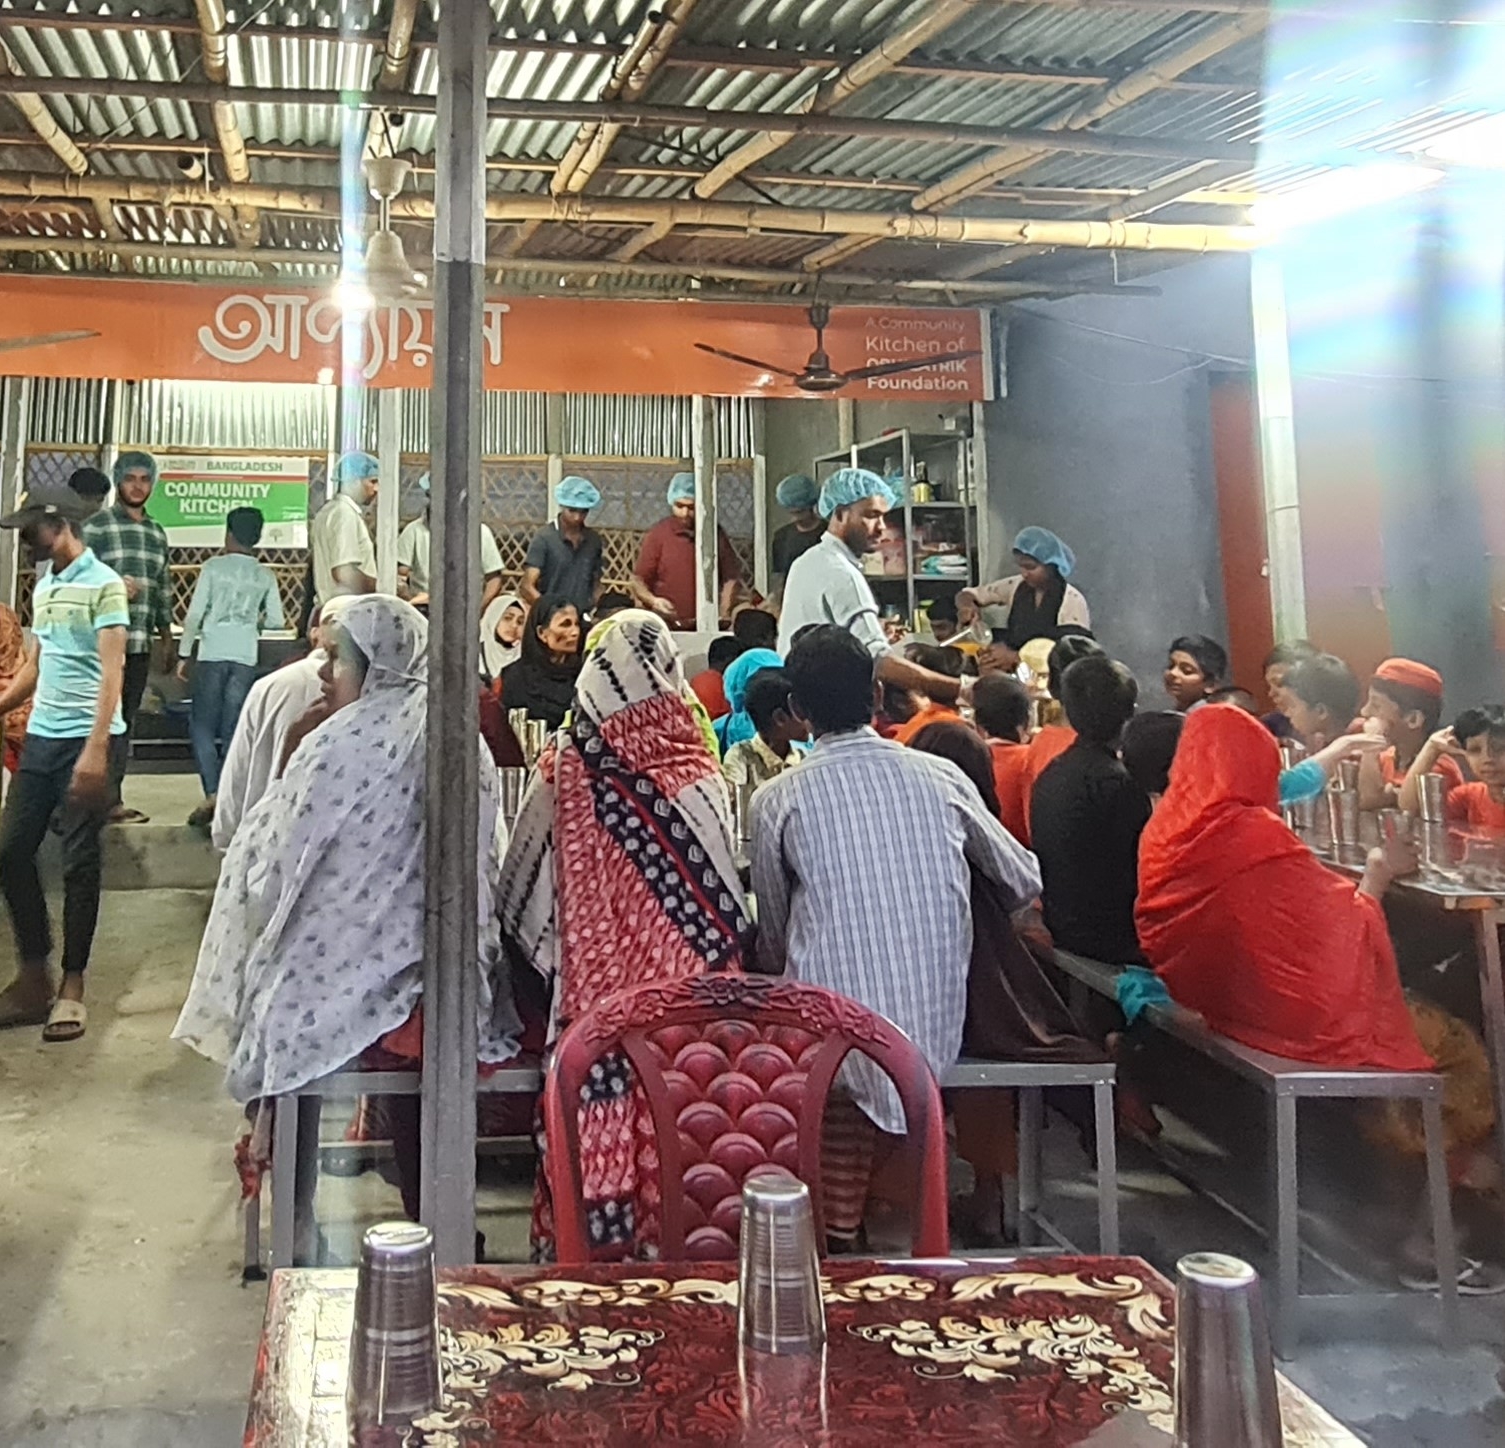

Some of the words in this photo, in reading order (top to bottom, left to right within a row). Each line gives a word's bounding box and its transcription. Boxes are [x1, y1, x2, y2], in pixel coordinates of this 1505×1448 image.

[865, 318, 876, 328] A
[879, 316, 966, 332] Community
[866, 336, 940, 352] Kitchen
[946, 337, 965, 353] of
[867, 375, 969, 391] Foundation
[207, 461, 283, 472] BANGLADESH
[165, 482, 271, 498] COMMUNITY
